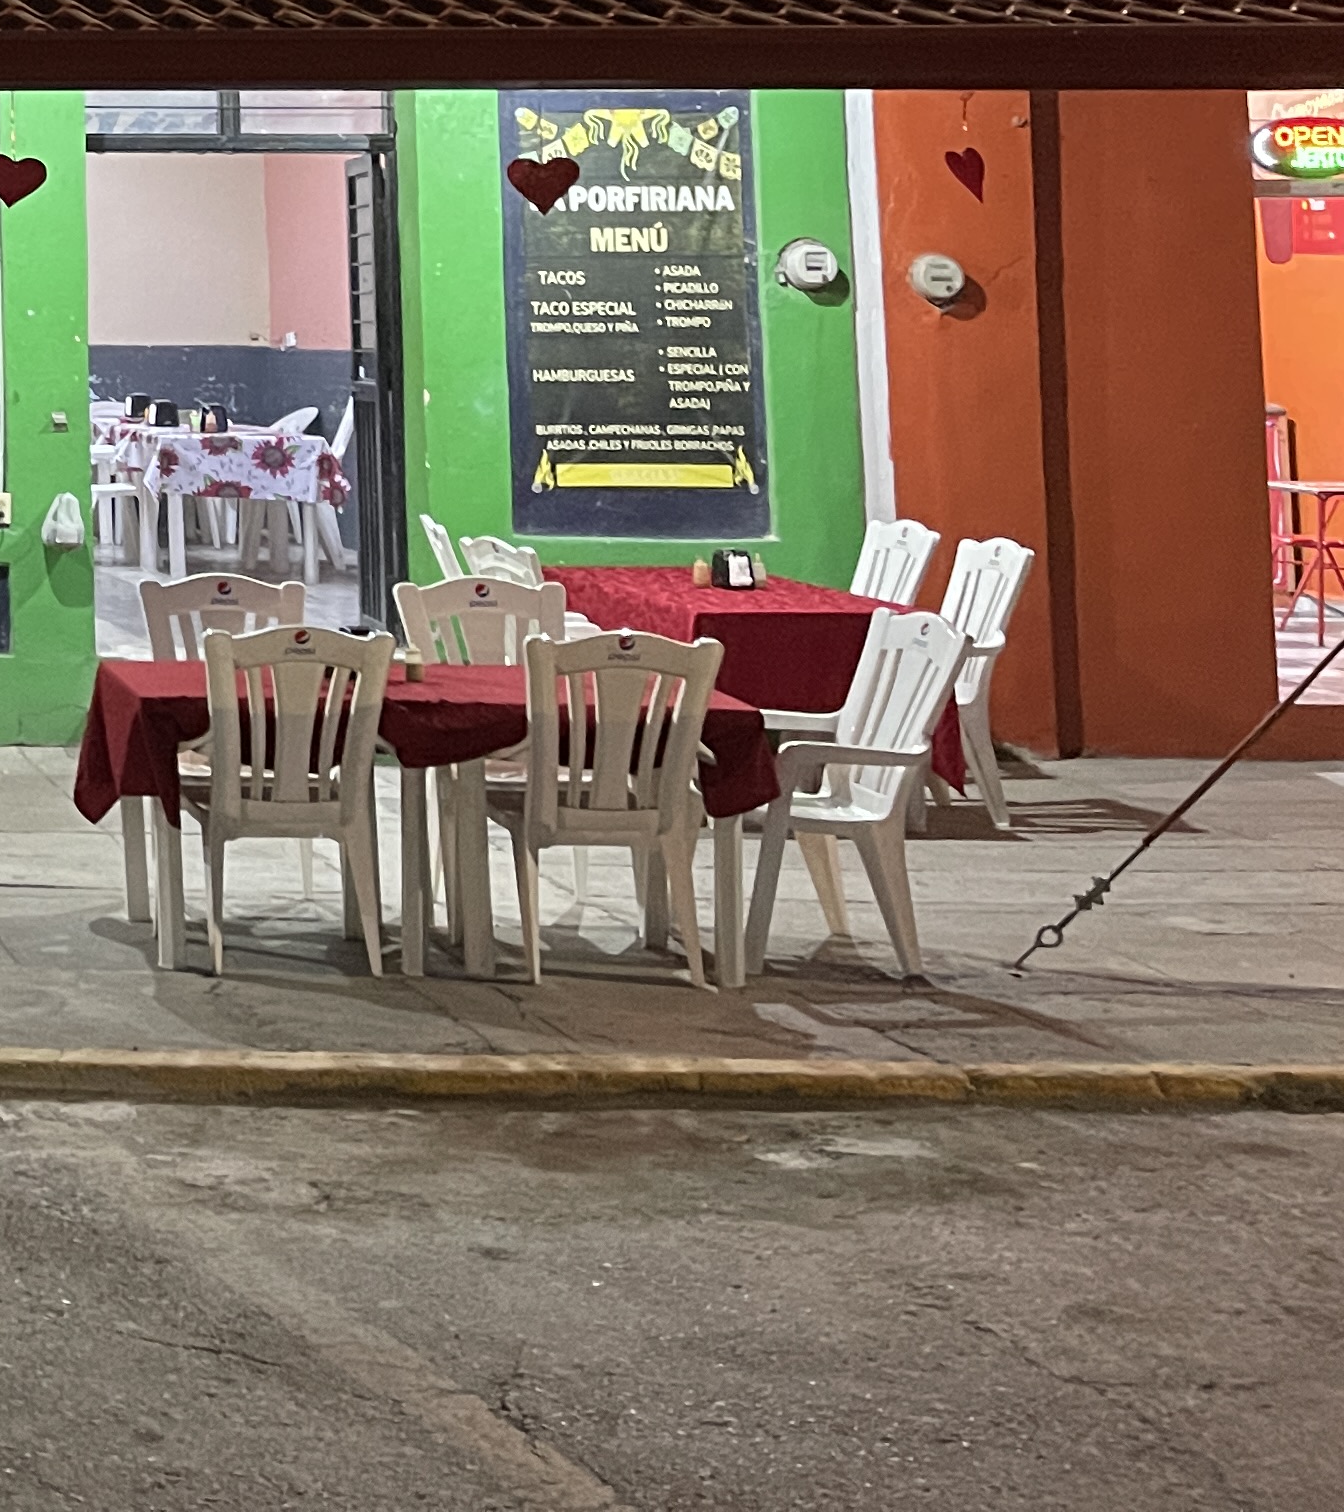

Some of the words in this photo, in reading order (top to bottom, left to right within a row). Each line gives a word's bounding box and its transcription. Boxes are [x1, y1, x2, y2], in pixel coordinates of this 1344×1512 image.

[568, 185, 736, 212] PORFIRIANA
[590, 221, 669, 253] MENÚ
[662, 265, 701, 276] ASADA
[538, 270, 586, 286] TACOS
[663, 282, 719, 294] PICADILLO
[530, 301, 570, 316] TACO
[572, 301, 637, 316] ESPECIAL
[665, 316, 711, 328] TROMPO
[666, 346, 717, 358] SENCILLA
[532, 369, 636, 383] HAMBURGUESAS
